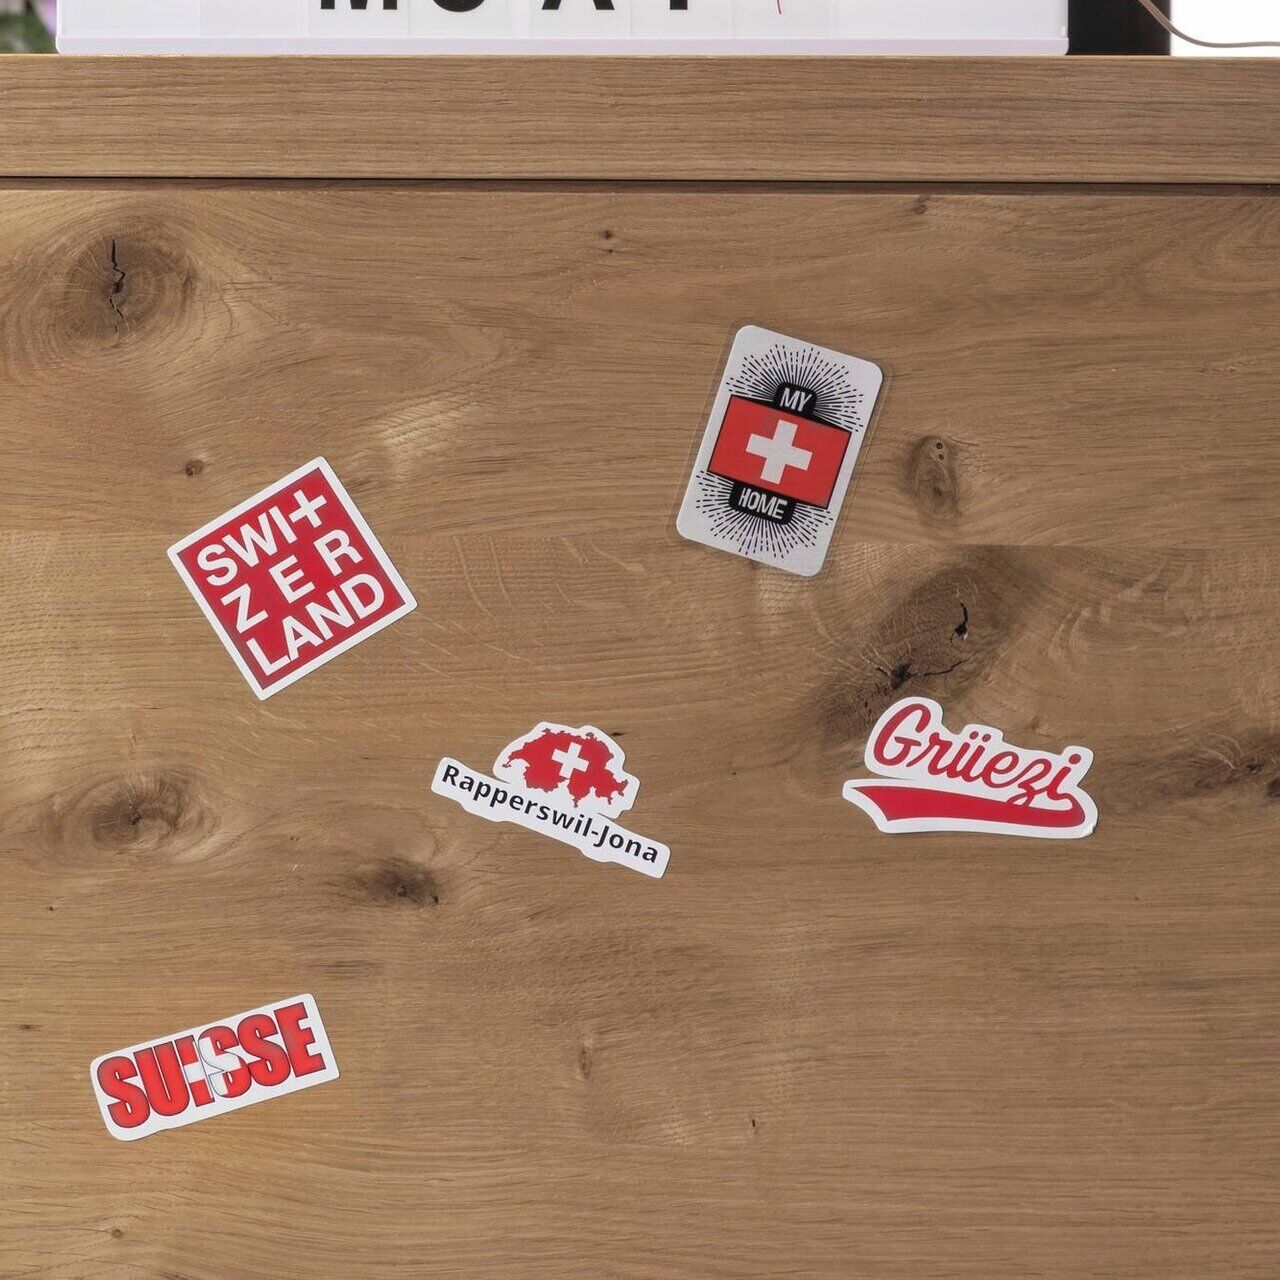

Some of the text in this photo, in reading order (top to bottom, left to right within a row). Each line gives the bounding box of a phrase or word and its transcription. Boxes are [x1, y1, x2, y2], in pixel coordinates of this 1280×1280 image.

[779, 387, 814, 413] MY
[738, 488, 788, 520] HOME
[245, 573, 385, 677] LAND
[873, 703, 1086, 807] Grüezi
[441, 764, 660, 864] Rapperswil-Jona
[96, 1001, 327, 1129] SUISSE
